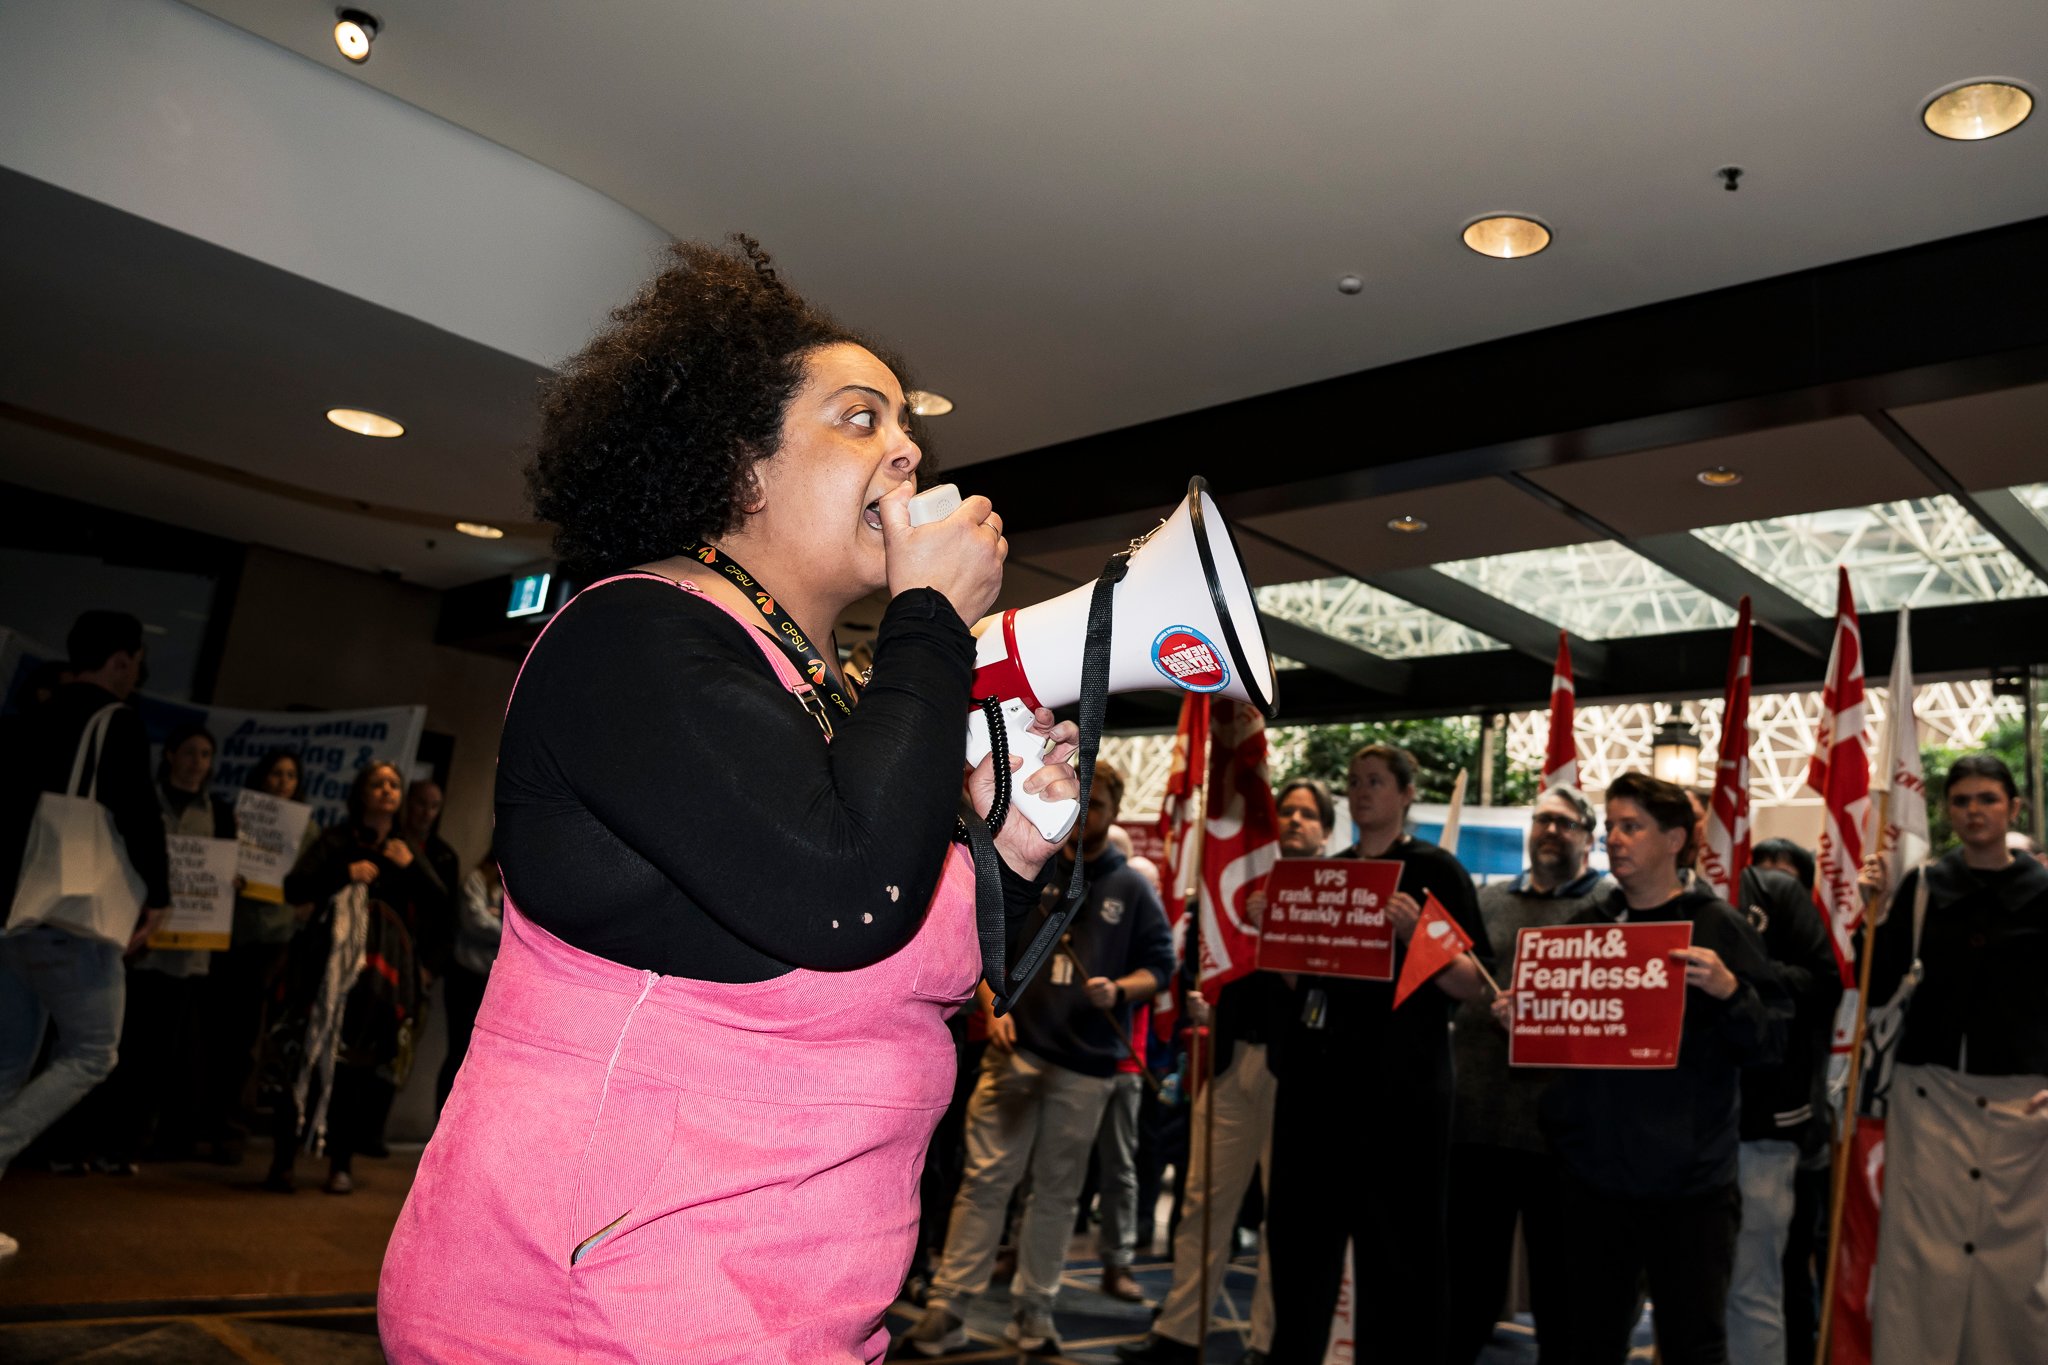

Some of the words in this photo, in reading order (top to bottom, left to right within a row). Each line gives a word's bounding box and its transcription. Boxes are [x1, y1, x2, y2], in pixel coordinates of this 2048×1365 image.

[724, 564, 754, 588] CPSU
[781, 621, 809, 653] CPSU
[1160, 643, 1210, 666] HEALTH
[1168, 654, 1214, 673] ALLIED
[1175, 663, 1217, 679] SUPPORT
[830, 693, 852, 716] CPS
[233, 718, 389, 741] Aralian
[223, 737, 345, 773] Nuing
[1314, 869, 1347, 886] VPS
[1279, 887, 1313, 903] rank
[1316, 889, 1347, 905] and
[1351, 888, 1378, 907] file
[1271, 904, 1285, 921] is
[1288, 905, 1341, 928] frankly
[1346, 908, 1385, 927] riled
[1521, 929, 1628, 960] Frank&
[1517, 958, 1669, 990] Fearless&
[1516, 991, 1624, 1021] Furious
[1568, 1024, 1581, 1036] to
[1583, 1025, 1601, 1036] the
[1604, 1023, 1628, 1036] VPS
